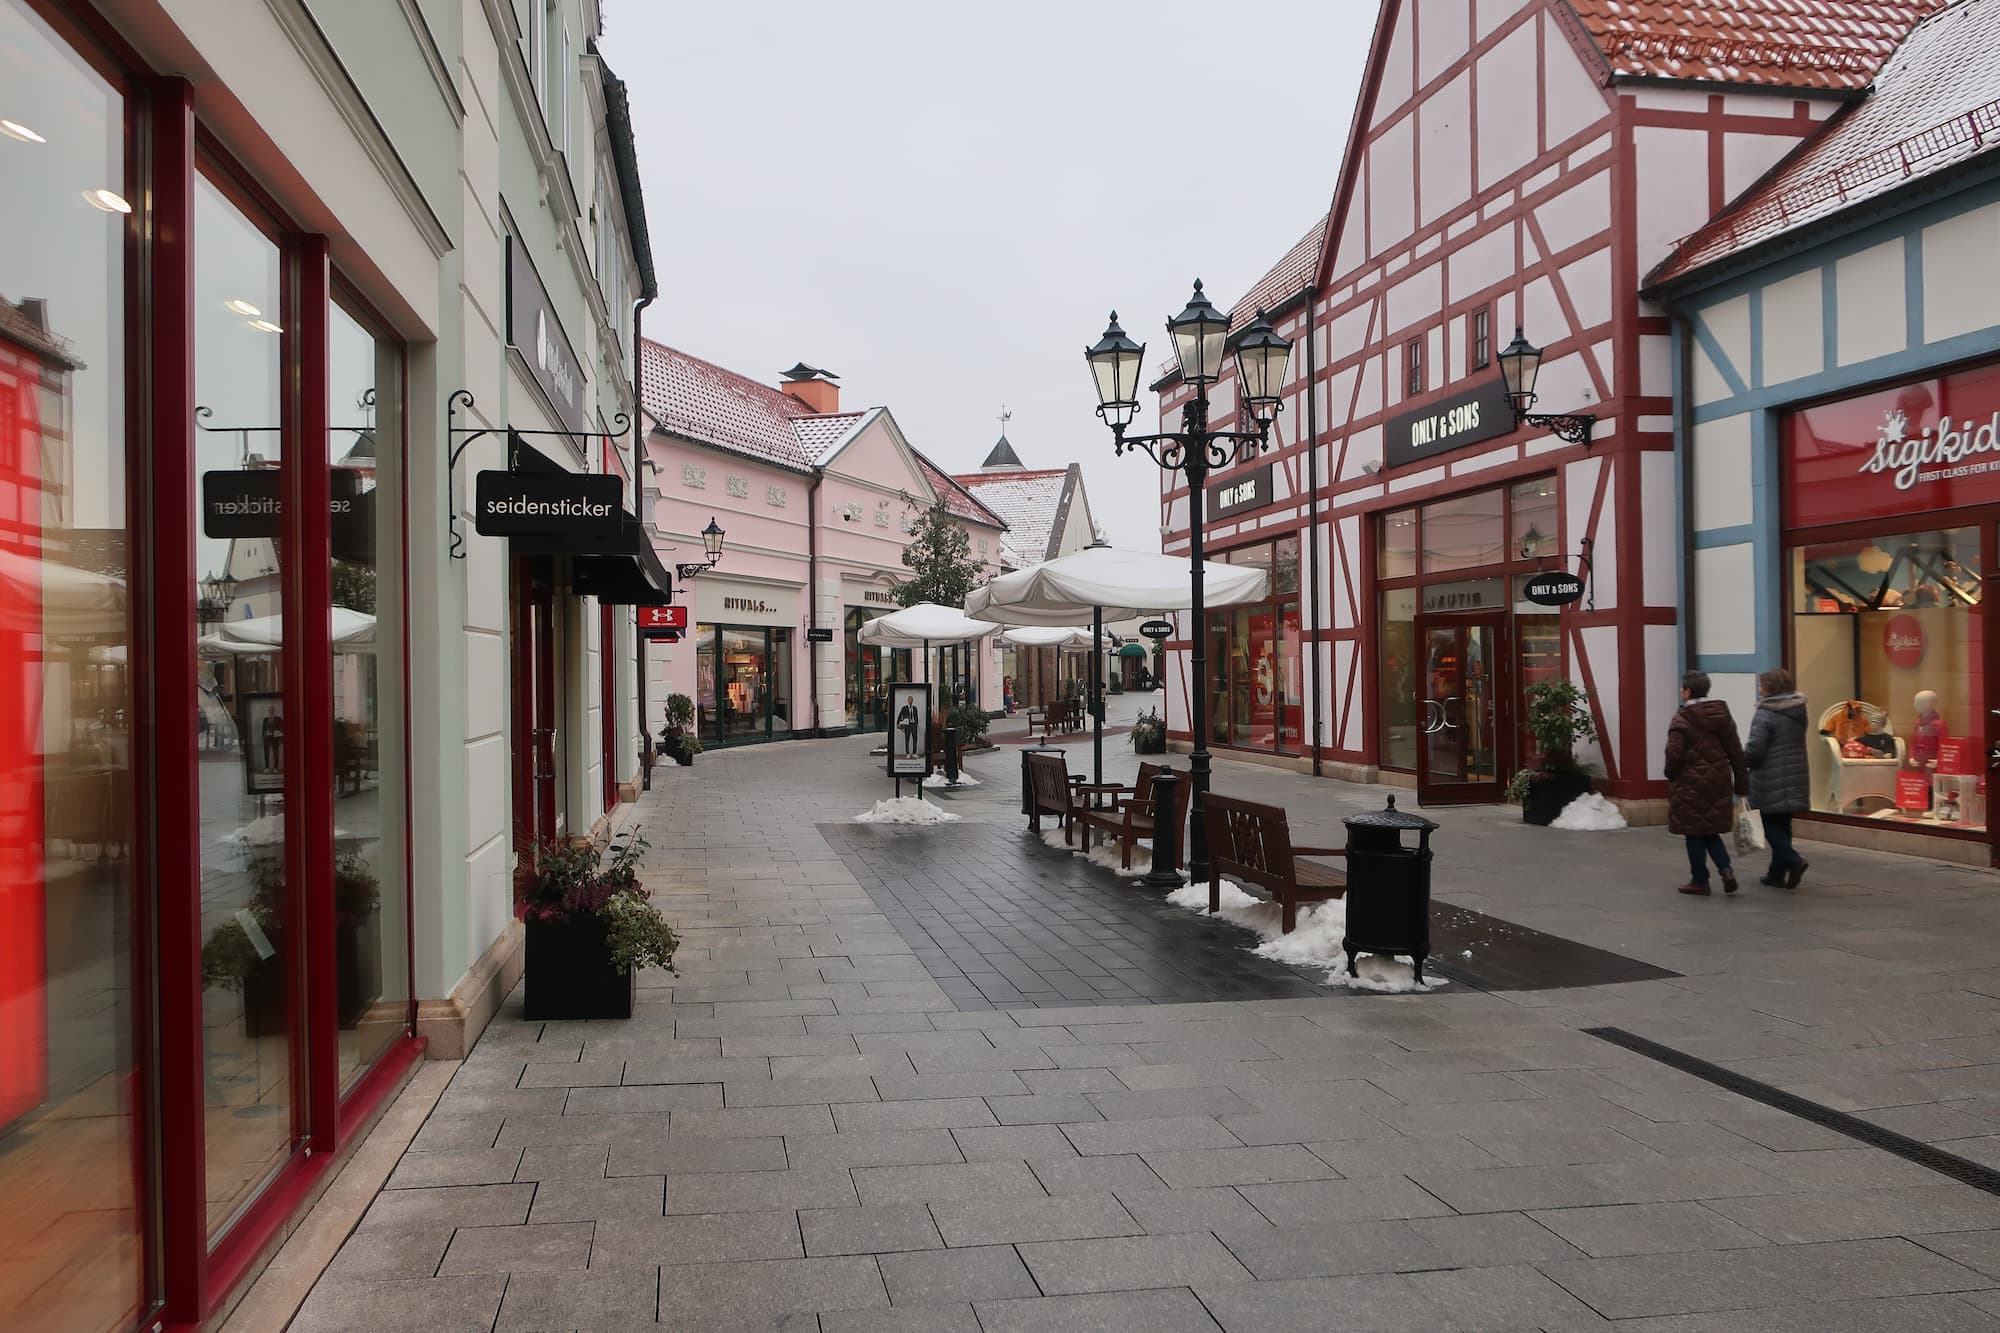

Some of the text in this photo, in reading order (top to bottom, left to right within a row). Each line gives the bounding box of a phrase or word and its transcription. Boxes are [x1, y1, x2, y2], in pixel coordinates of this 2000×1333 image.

[1411, 401, 1480, 448] ONLY & SONS
[1858, 409, 2000, 490] sigikid
[1919, 460, 2000, 482] FIRST CLASS FOR KI
[487, 494, 612, 517] seidensticker
[1220, 479, 1256, 509] ONLY & SONS
[1531, 583, 1579, 596] ONLY & SONS
